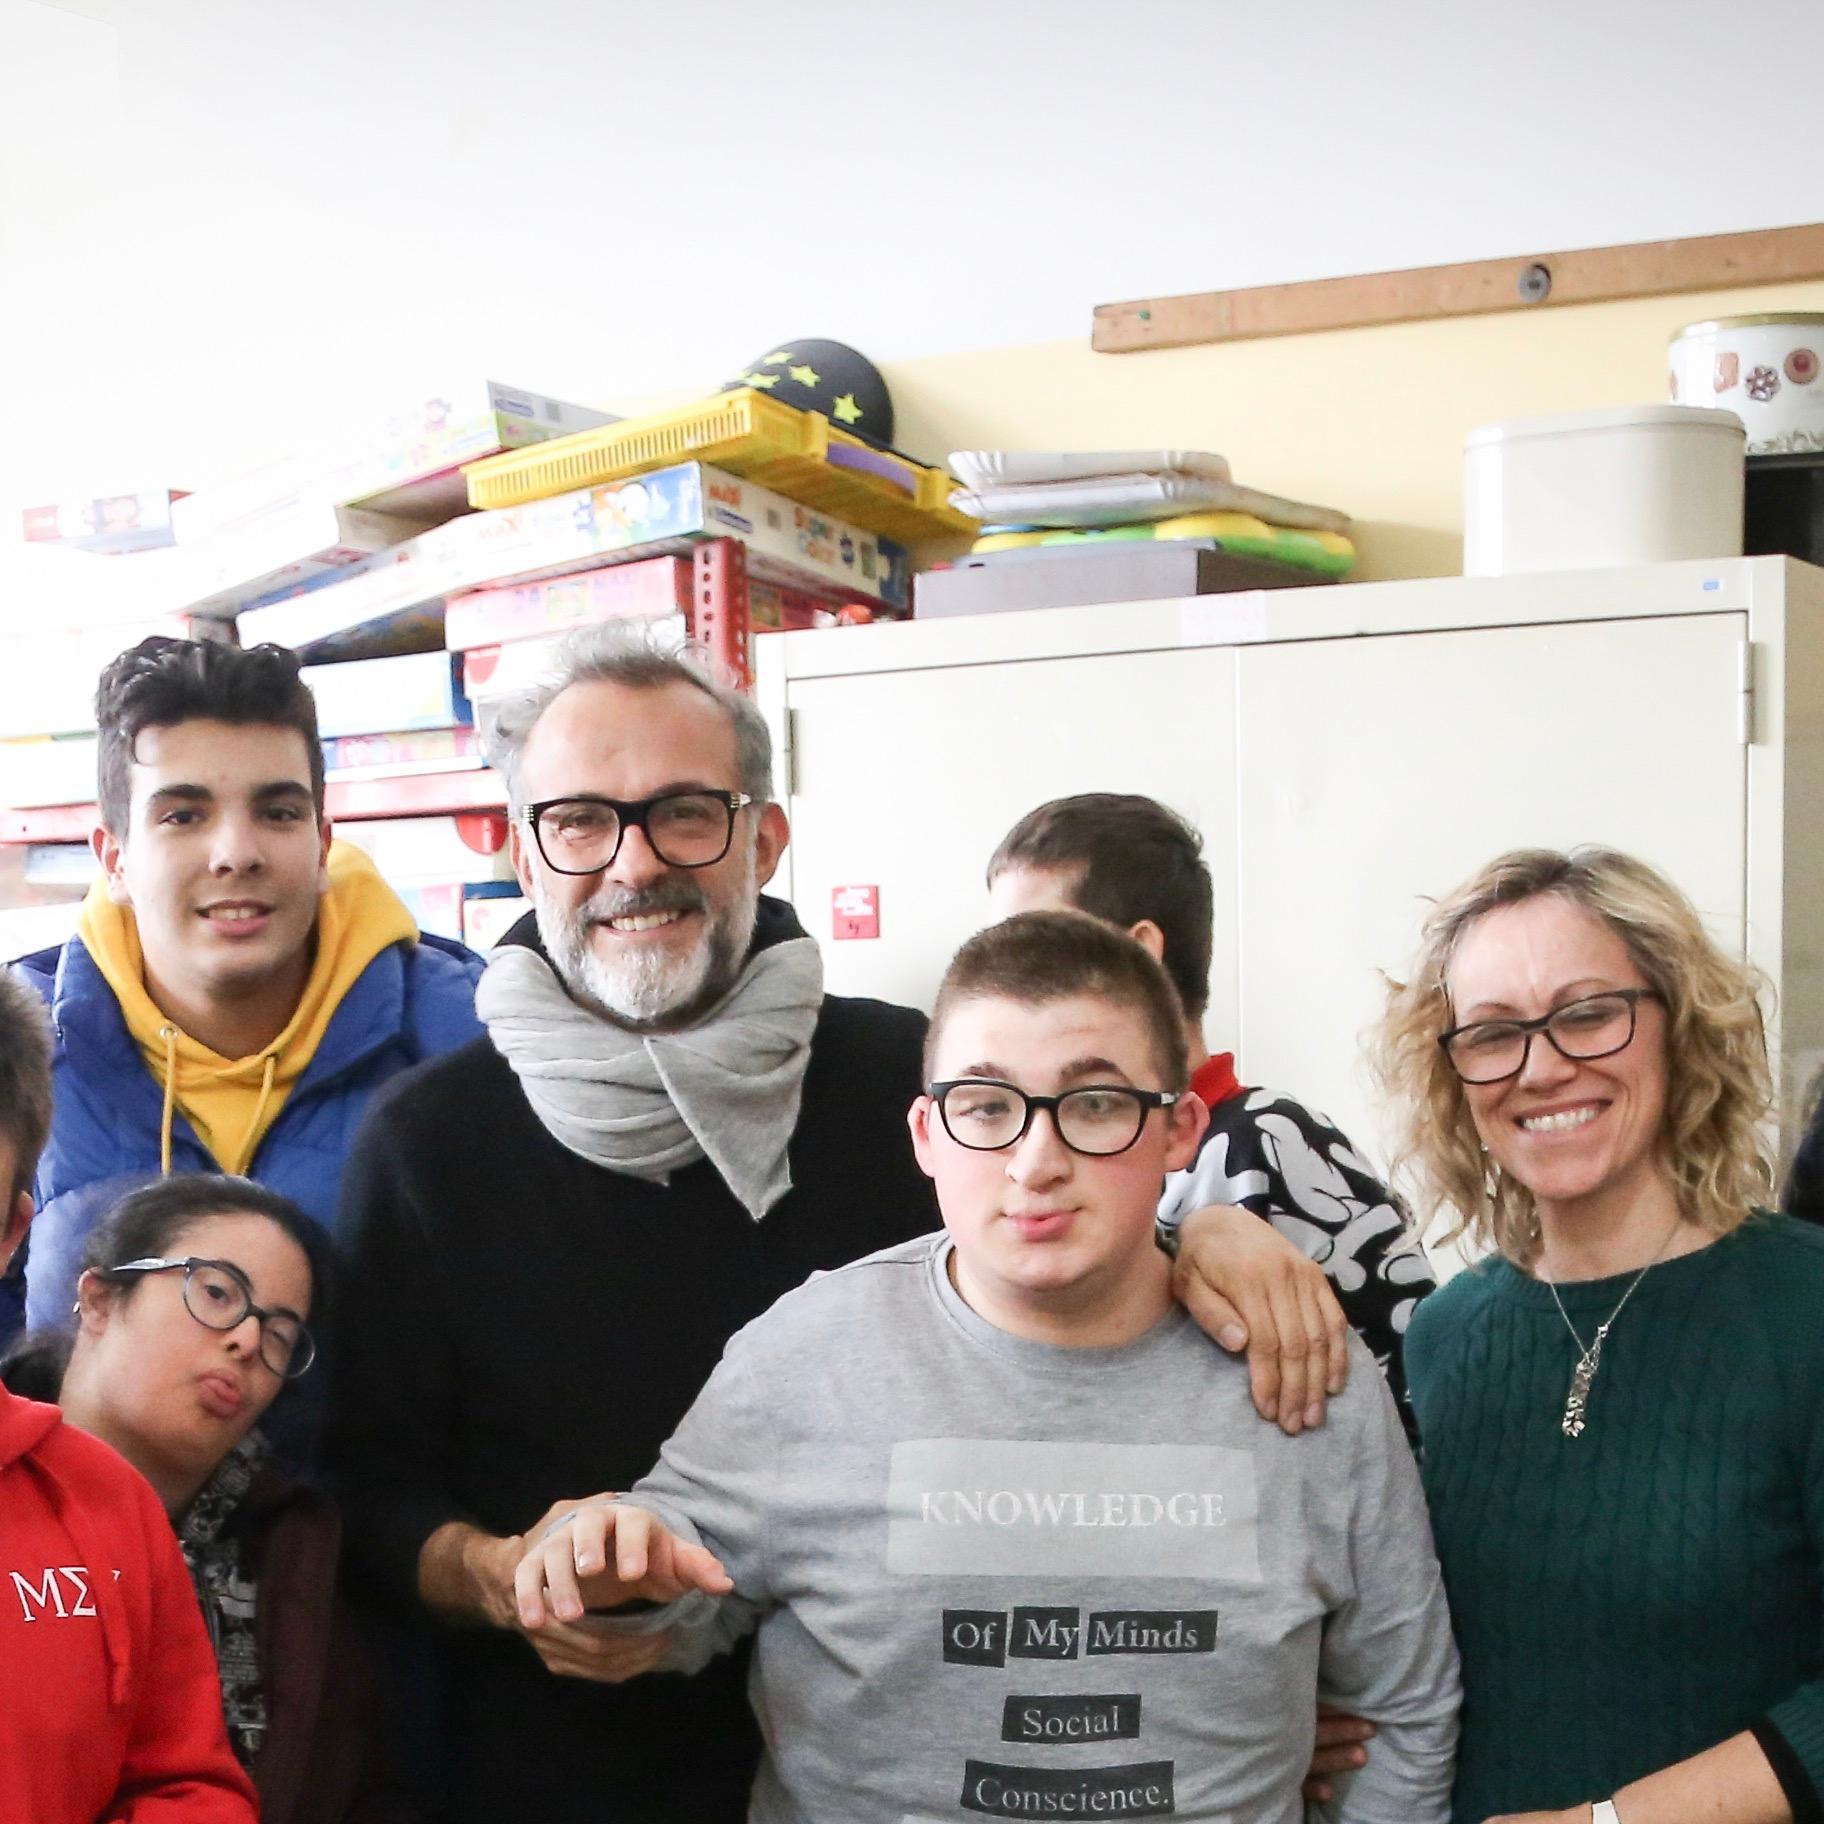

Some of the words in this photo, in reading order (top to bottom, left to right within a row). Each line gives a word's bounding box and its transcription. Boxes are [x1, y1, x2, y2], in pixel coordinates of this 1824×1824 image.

[921, 1490, 1226, 1527] KNOWLEDGE
[951, 1621, 997, 1650] Of
[1024, 1618, 1081, 1655] My
[1091, 1619, 1199, 1649] Minds
[1023, 1705, 1120, 1737] Social
[975, 1777, 1170, 1813] Conscience.
